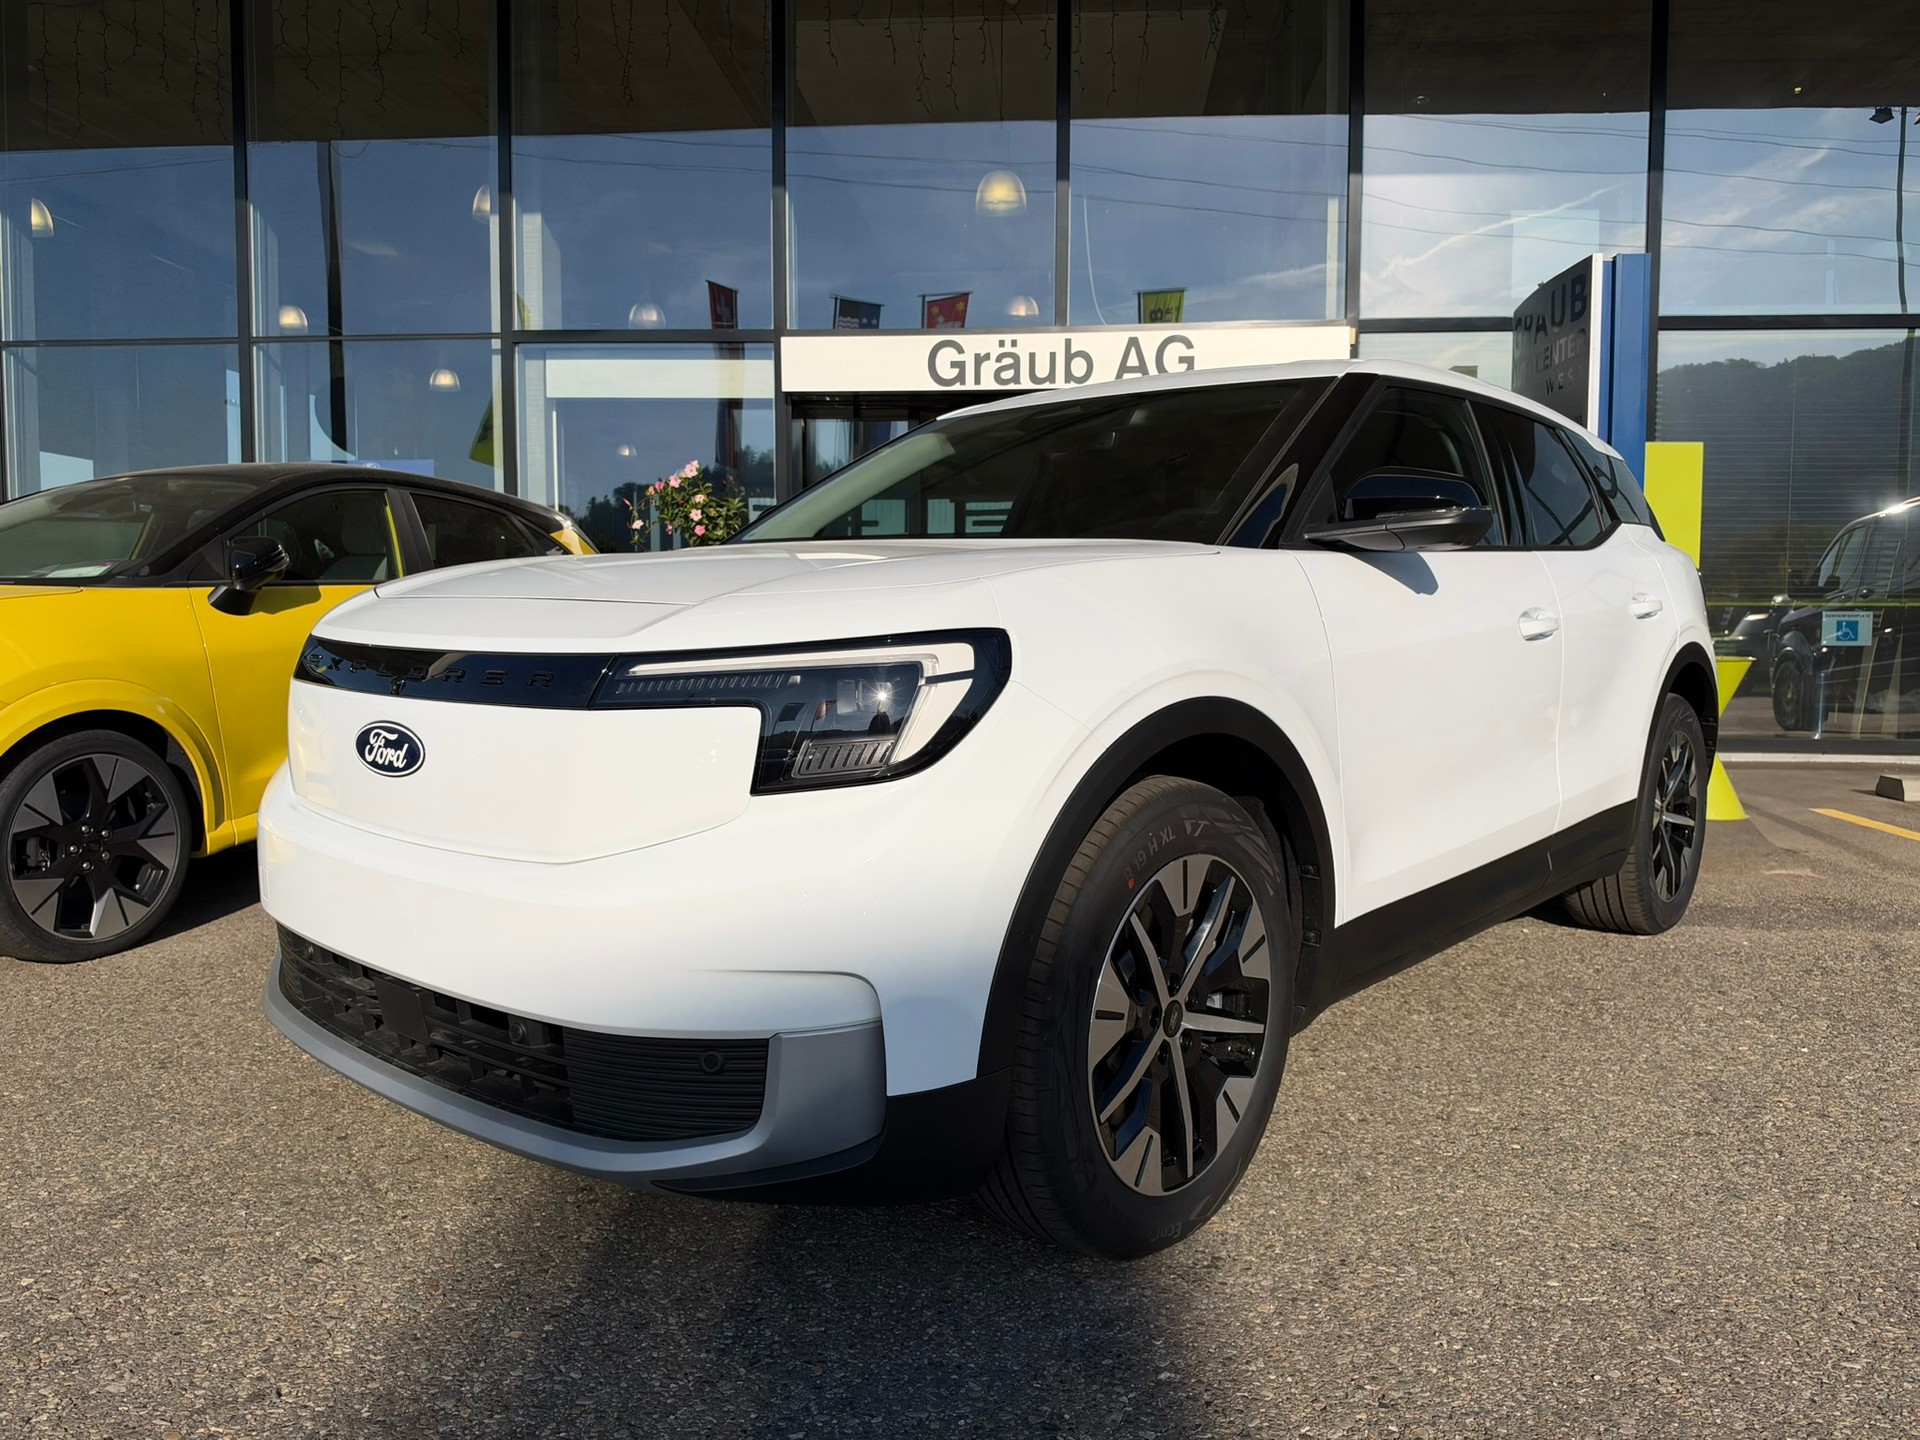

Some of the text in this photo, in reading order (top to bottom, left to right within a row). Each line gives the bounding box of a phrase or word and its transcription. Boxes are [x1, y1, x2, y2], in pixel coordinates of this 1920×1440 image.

[927, 334, 1196, 388] Gräub AG
[365, 729, 409, 769] Ford
